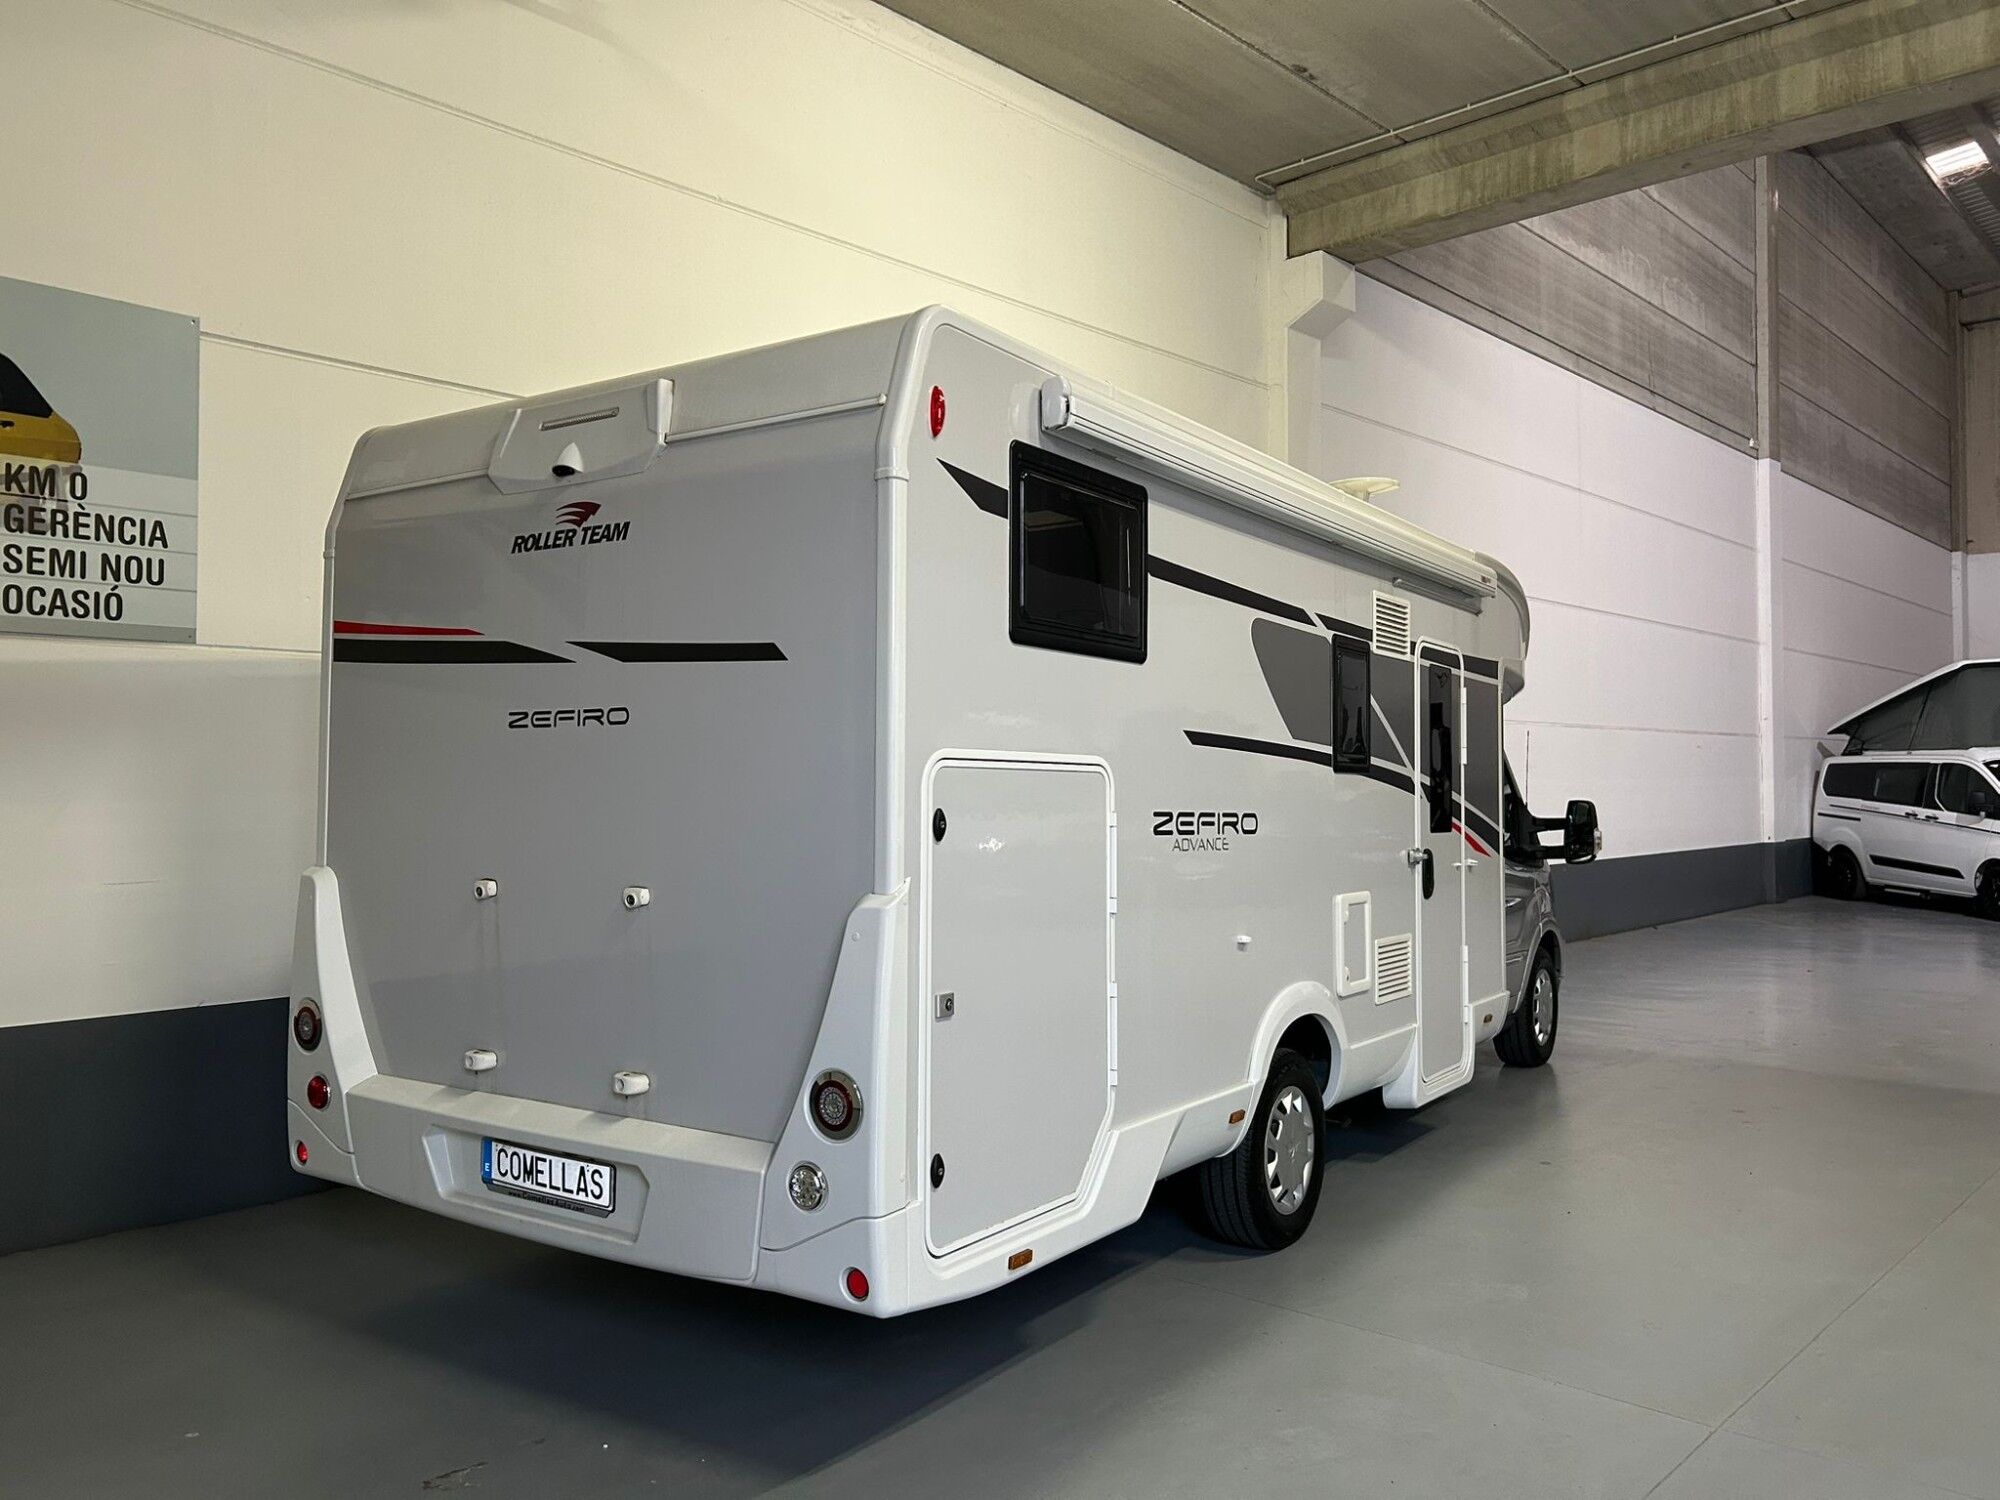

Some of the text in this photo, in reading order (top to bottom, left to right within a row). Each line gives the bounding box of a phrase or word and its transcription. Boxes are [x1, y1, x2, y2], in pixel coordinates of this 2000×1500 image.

[5, 462, 56, 497] KM
[3, 502, 169, 549] GERÈNCIA
[511, 521, 631, 554] ROLLER TEAM
[2, 543, 165, 587] SEMI NOU
[2, 583, 124, 622] OCASIÓ
[508, 706, 630, 729] ZEFIRO
[1152, 811, 1259, 836] ZEFIRO
[1172, 837, 1230, 852] ADVANCE
[484, 1162, 491, 1172] E
[496, 1148, 604, 1200] COMELLAS
